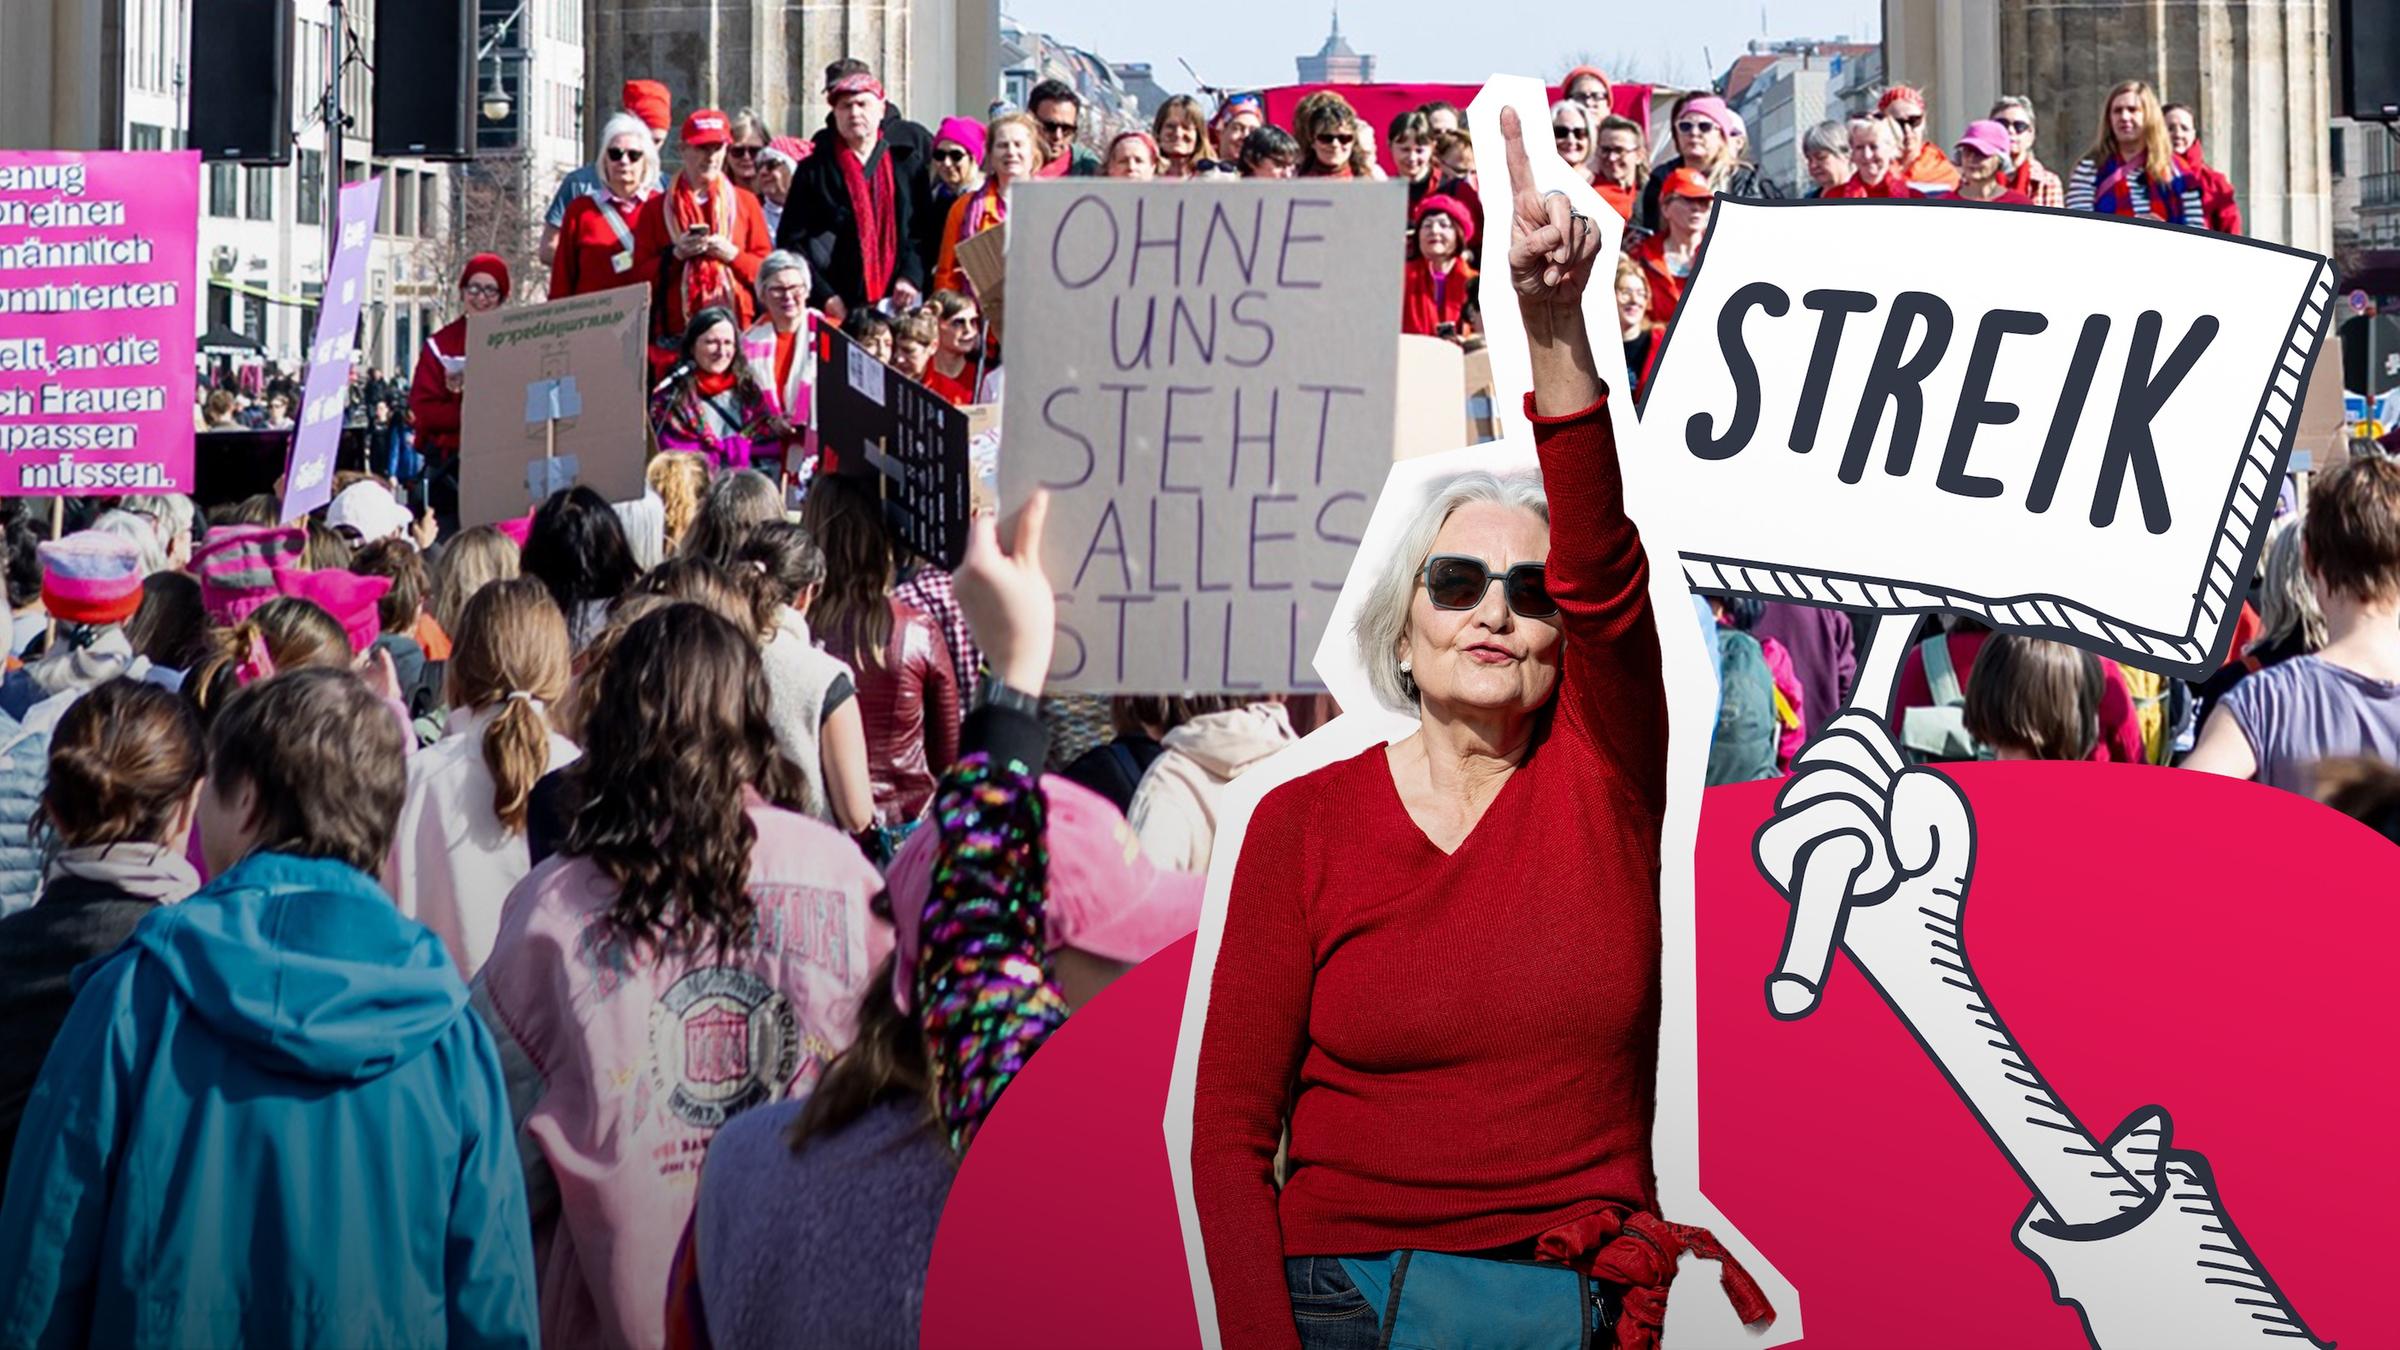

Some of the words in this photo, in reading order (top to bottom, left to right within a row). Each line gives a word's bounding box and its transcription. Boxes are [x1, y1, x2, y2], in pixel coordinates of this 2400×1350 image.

[1051, 194, 1334, 291] OHNE
[0, 281, 179, 313] minierten
[1110, 290, 1275, 372] UNS
[0, 424, 137, 454] passen
[40, 382, 166, 414] Frauen
[1038, 382, 1366, 494] STEHT
[19, 456, 174, 487] müssen.
[1073, 491, 1368, 593] ALLES
[1050, 593, 1325, 690] STILL
